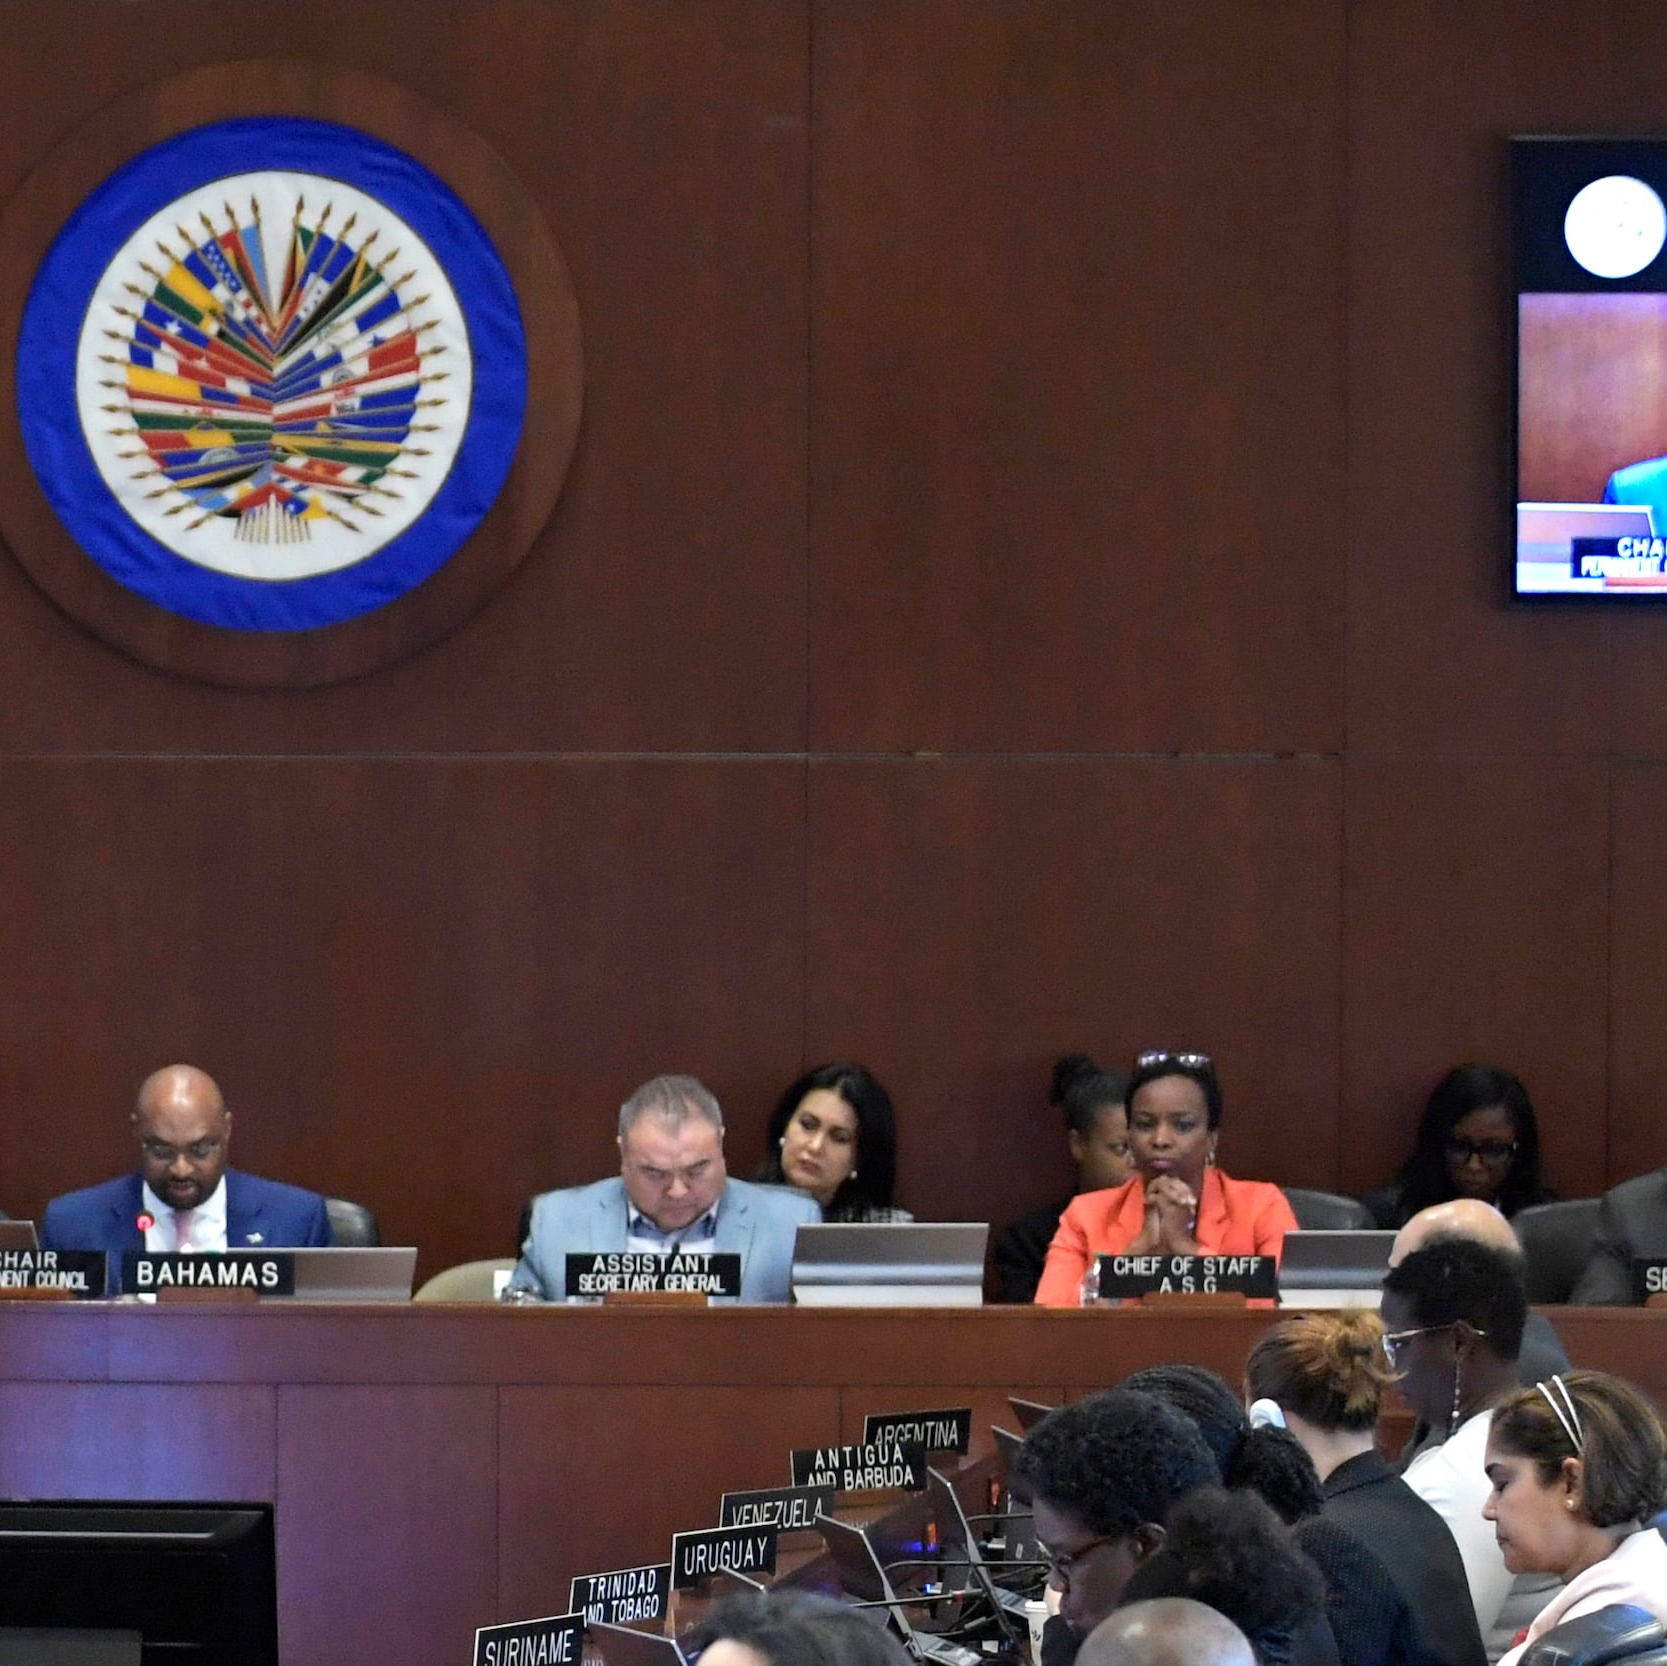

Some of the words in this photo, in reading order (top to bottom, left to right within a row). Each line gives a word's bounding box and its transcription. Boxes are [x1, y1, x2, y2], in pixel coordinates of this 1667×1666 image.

[1617, 537, 1667, 557] CHA
[136, 1261, 280, 1287] BAHAMAS
[592, 1254, 713, 1273] ASSISTANT
[1113, 1256, 1161, 1275] CHIEF
[1171, 1256, 1195, 1275] OF
[1203, 1256, 1261, 1275] STAFF
[34, 1270, 90, 1289] COUNCIL
[579, 1274, 659, 1292] SECRETARY
[664, 1274, 726, 1292] GENERAL
[874, 1420, 959, 1448] ARGENTINA
[814, 1443, 903, 1470] ANTIGUA
[807, 1471, 837, 1487] AND
[844, 1464, 915, 1490] BARBUDA
[732, 1497, 823, 1529] VENEZUELA
[684, 1536, 768, 1575] URUGUAY
[589, 1569, 656, 1602] TRINIDAD
[611, 1594, 659, 1624] TOBAGO
